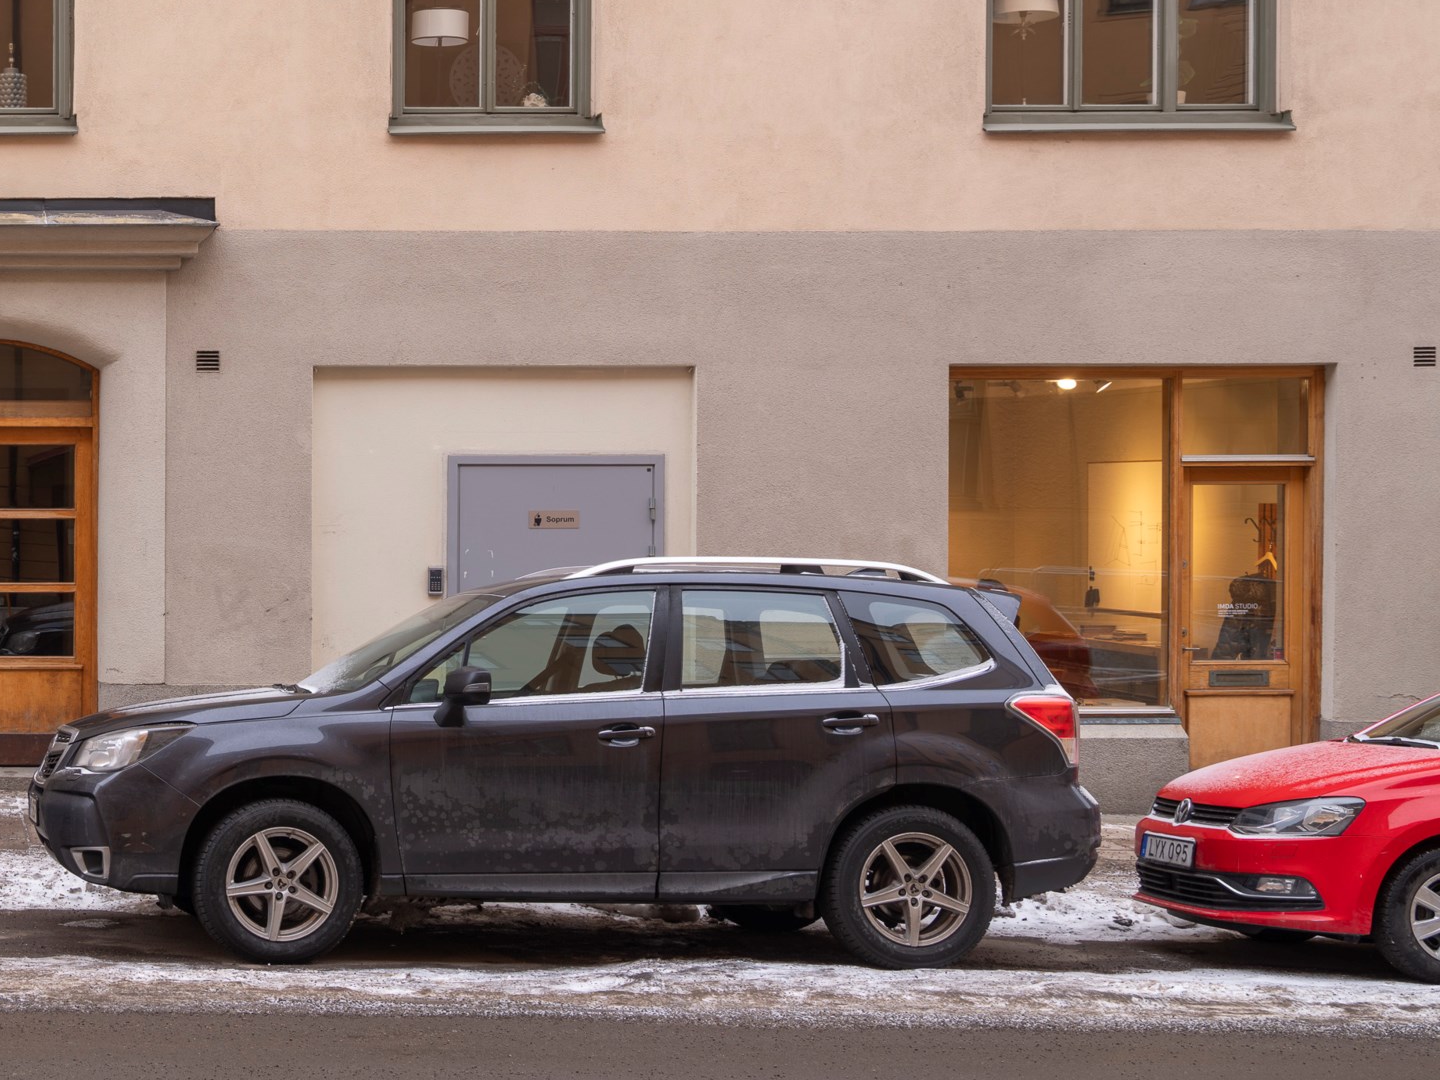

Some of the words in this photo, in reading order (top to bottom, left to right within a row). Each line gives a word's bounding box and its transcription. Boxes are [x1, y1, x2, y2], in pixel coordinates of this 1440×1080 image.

[546, 515, 575, 524] Soprum
[1148, 838, 1167, 860] LYX
[1168, 842, 1189, 863] 095
